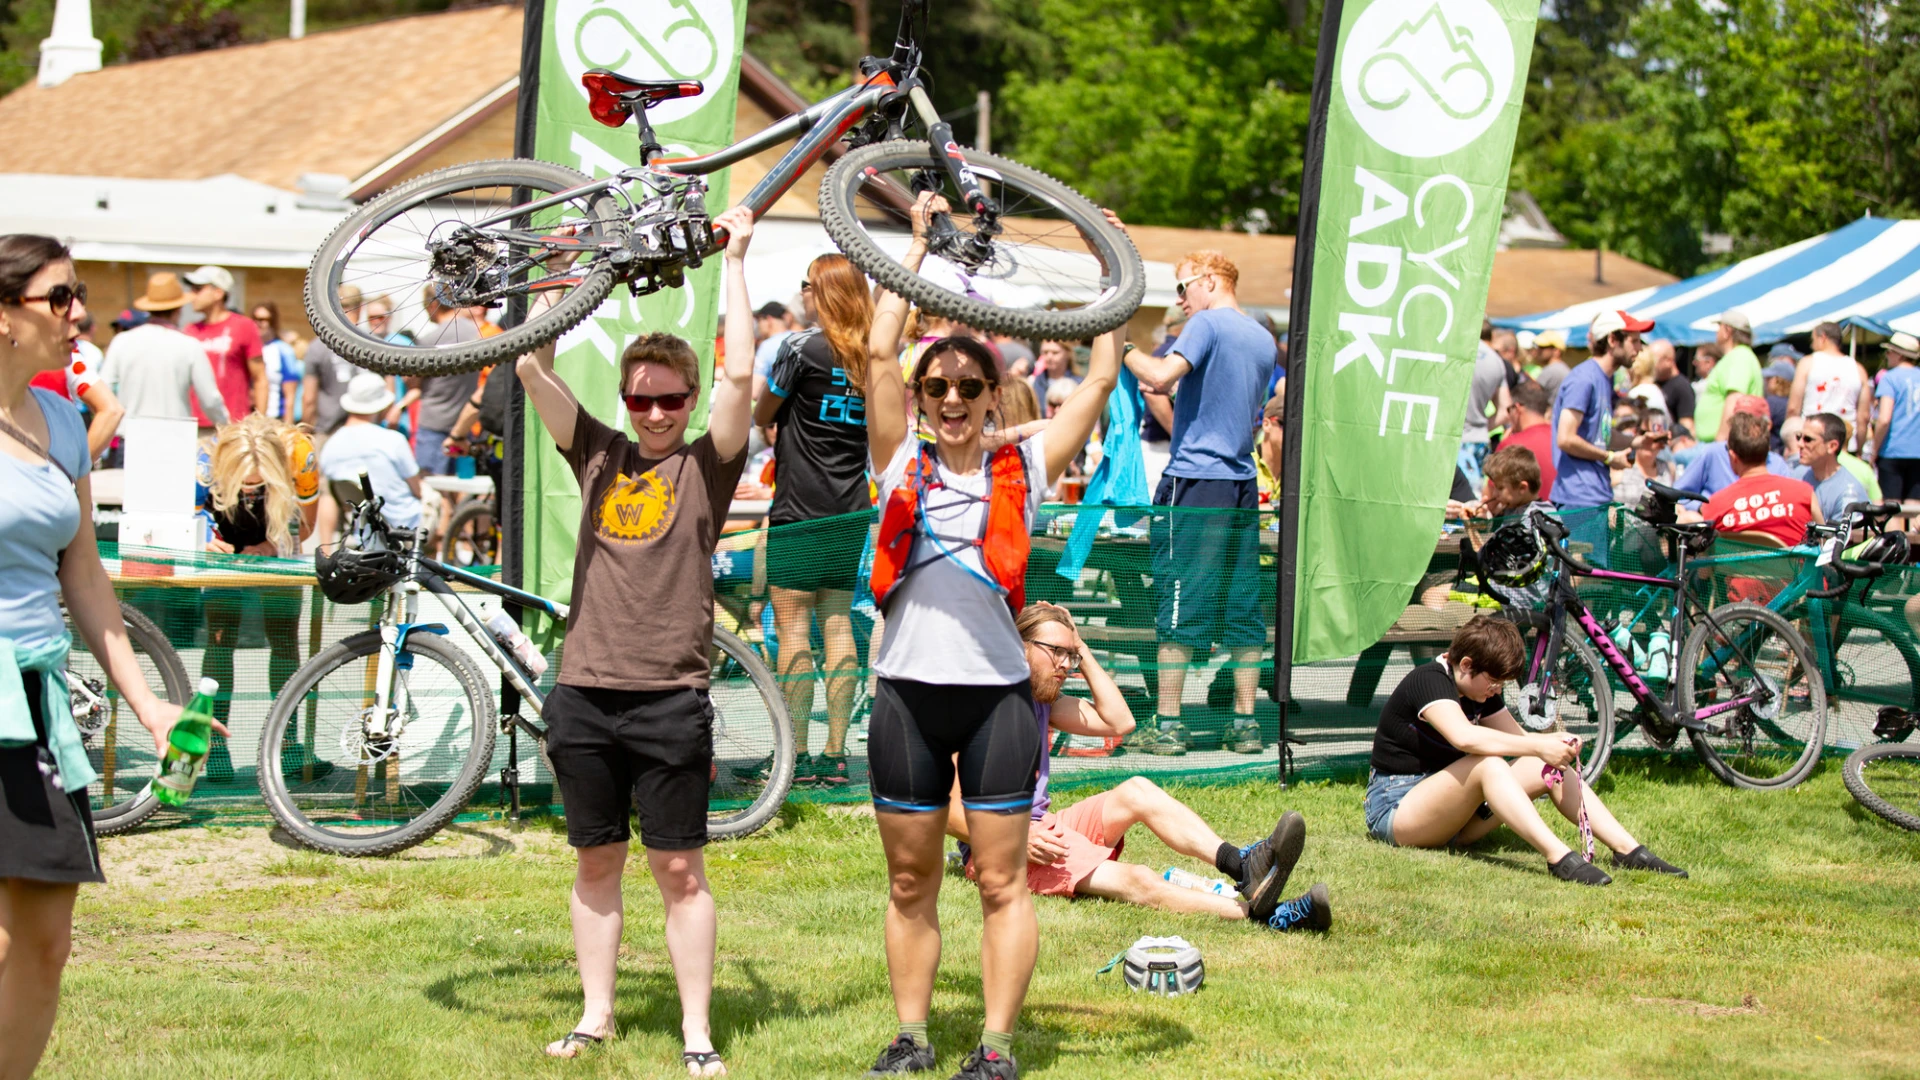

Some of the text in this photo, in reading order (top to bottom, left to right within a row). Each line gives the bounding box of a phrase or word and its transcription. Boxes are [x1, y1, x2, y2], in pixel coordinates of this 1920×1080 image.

[362, 166, 474, 217] SCHWALBE
[1333, 165, 1409, 378] ADK
[1378, 174, 1474, 441] CYCLE
[819, 394, 867, 426] BE
[615, 503, 645, 527] W
[1734, 490, 1780, 511] GOT
[647, 511, 675, 542] FESTIVAL
[454, 660, 480, 706] BONTRAGER
